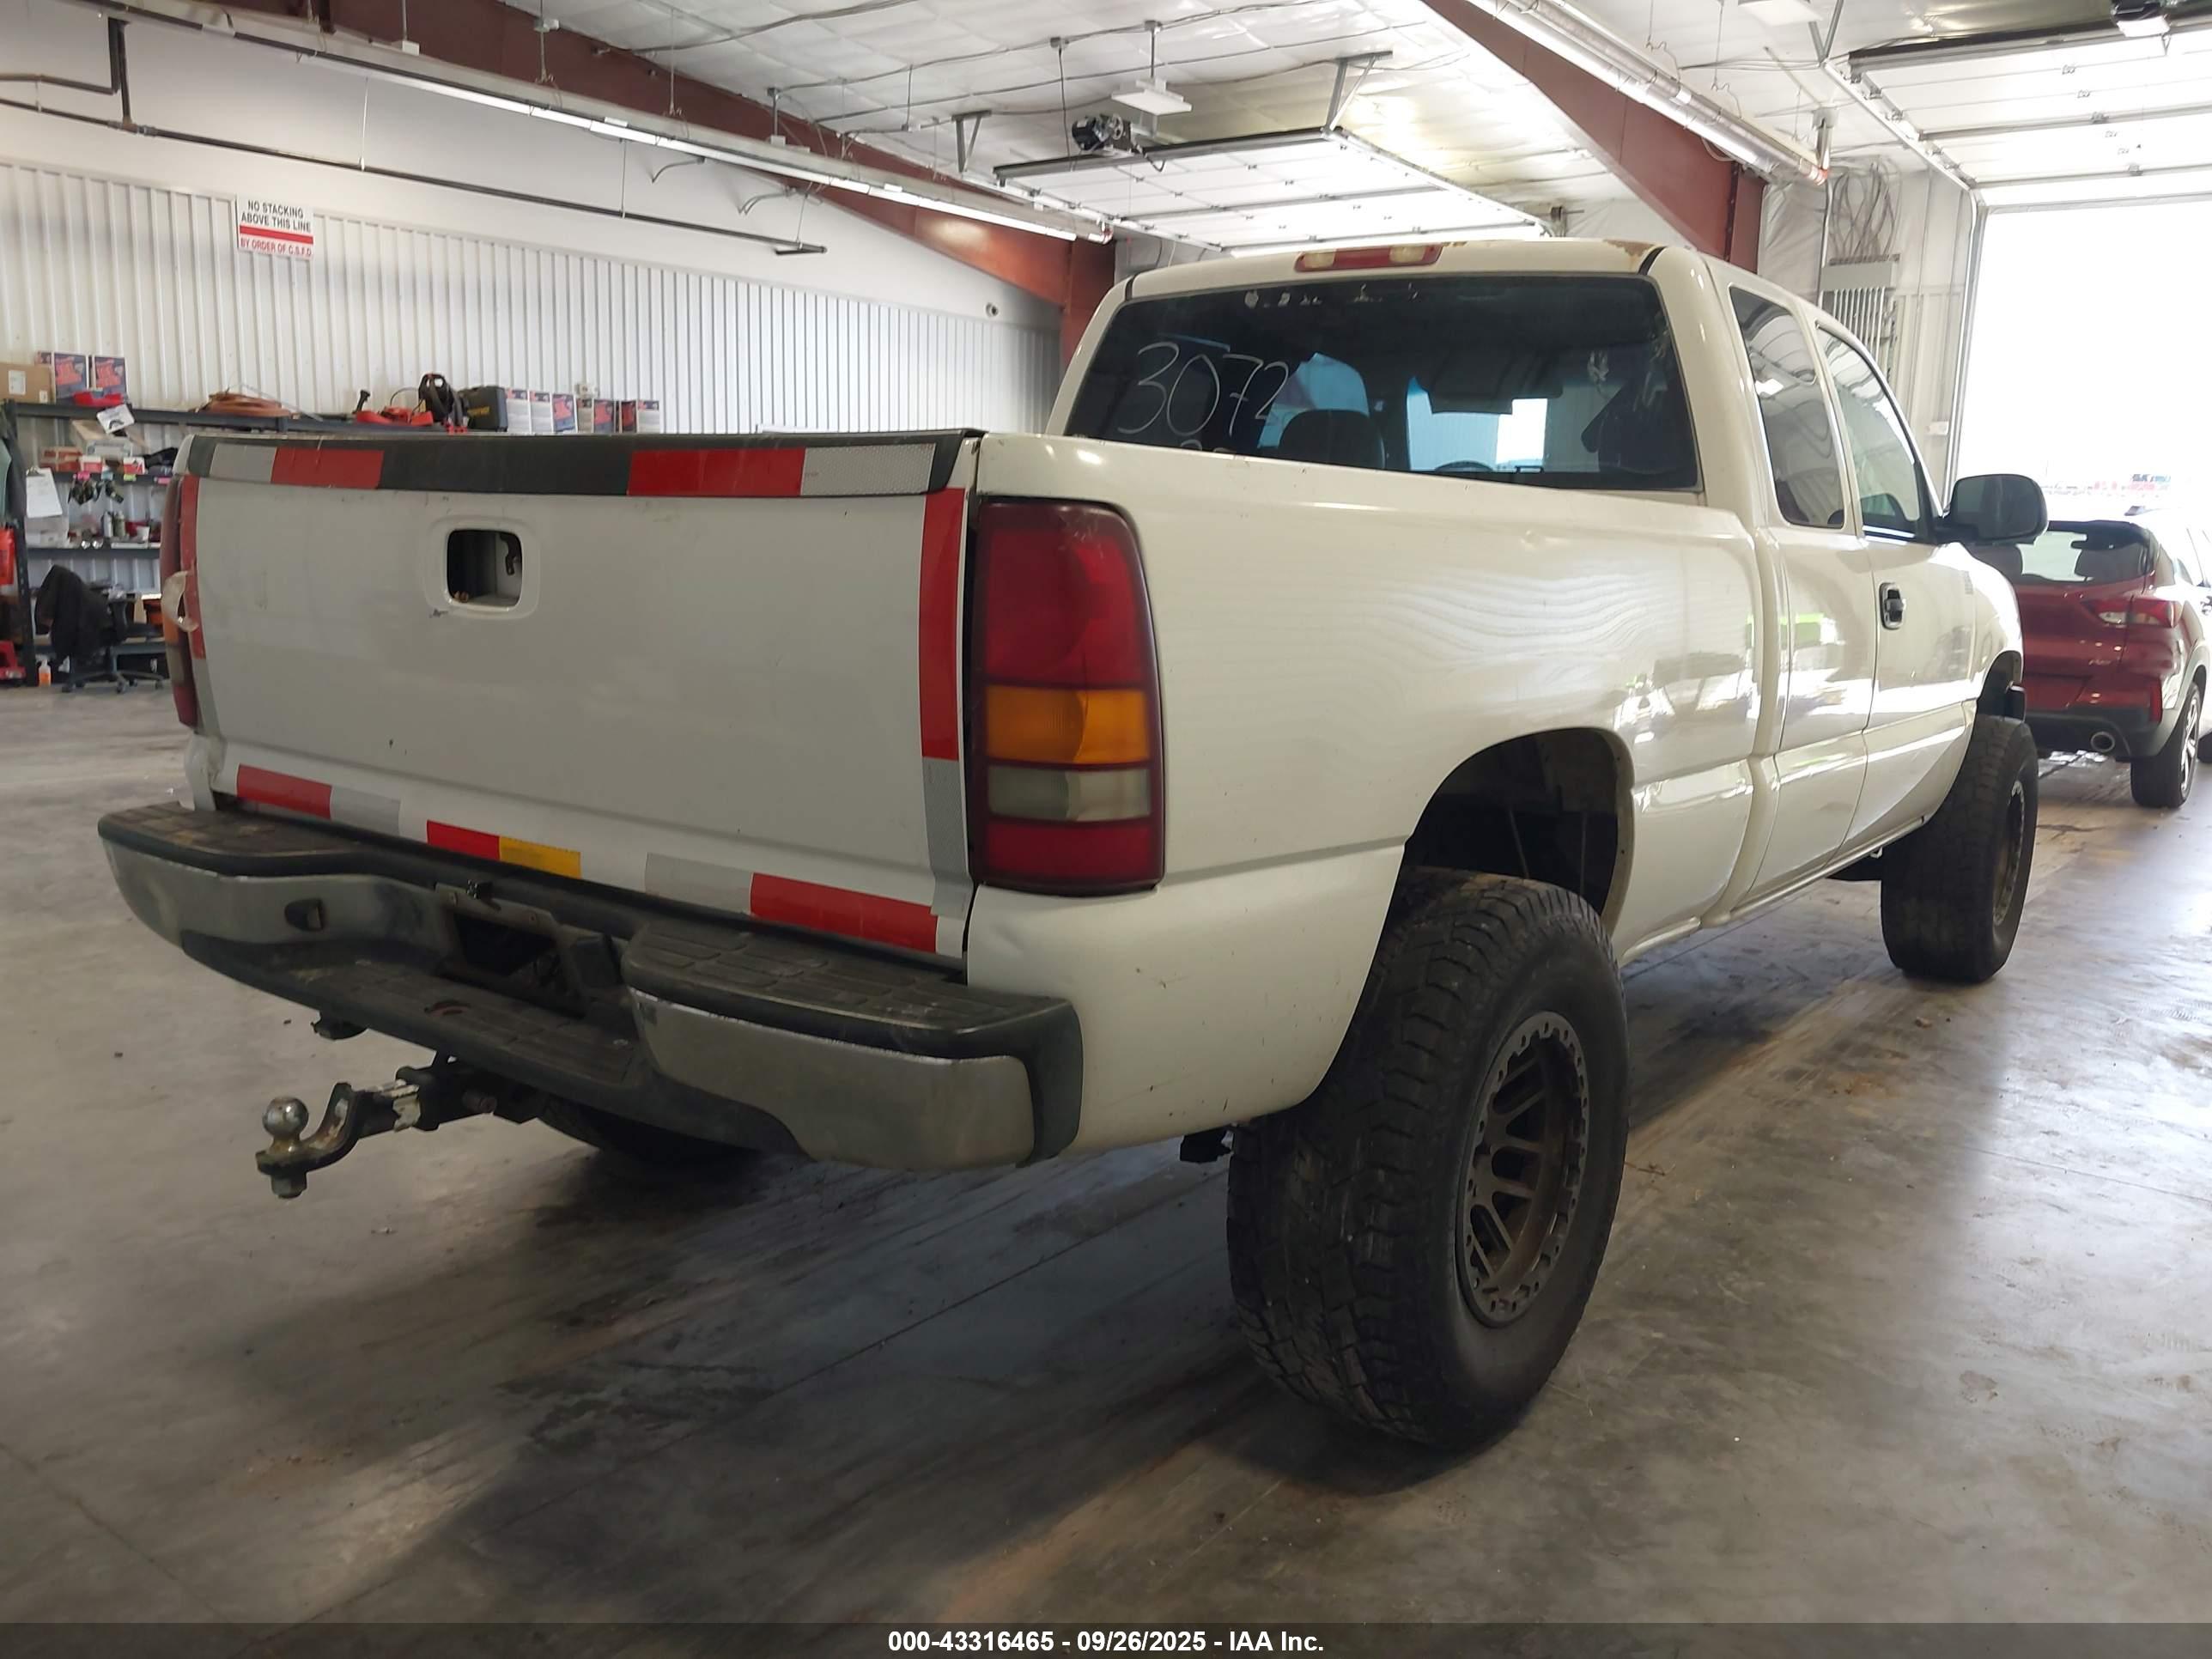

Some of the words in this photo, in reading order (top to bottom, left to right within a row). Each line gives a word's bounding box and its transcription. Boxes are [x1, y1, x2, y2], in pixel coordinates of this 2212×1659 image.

[248, 199, 259, 212] NO
[263, 202, 304, 219] STACKING
[241, 212, 270, 226] ABOVE
[272, 216, 290, 229] THIS
[293, 220, 311, 233] LINE
[240, 238, 250, 248] BY
[252, 240, 276, 253] ORDER
[277, 243, 286, 253] OF
[1117, 341, 1289, 437] 3072
